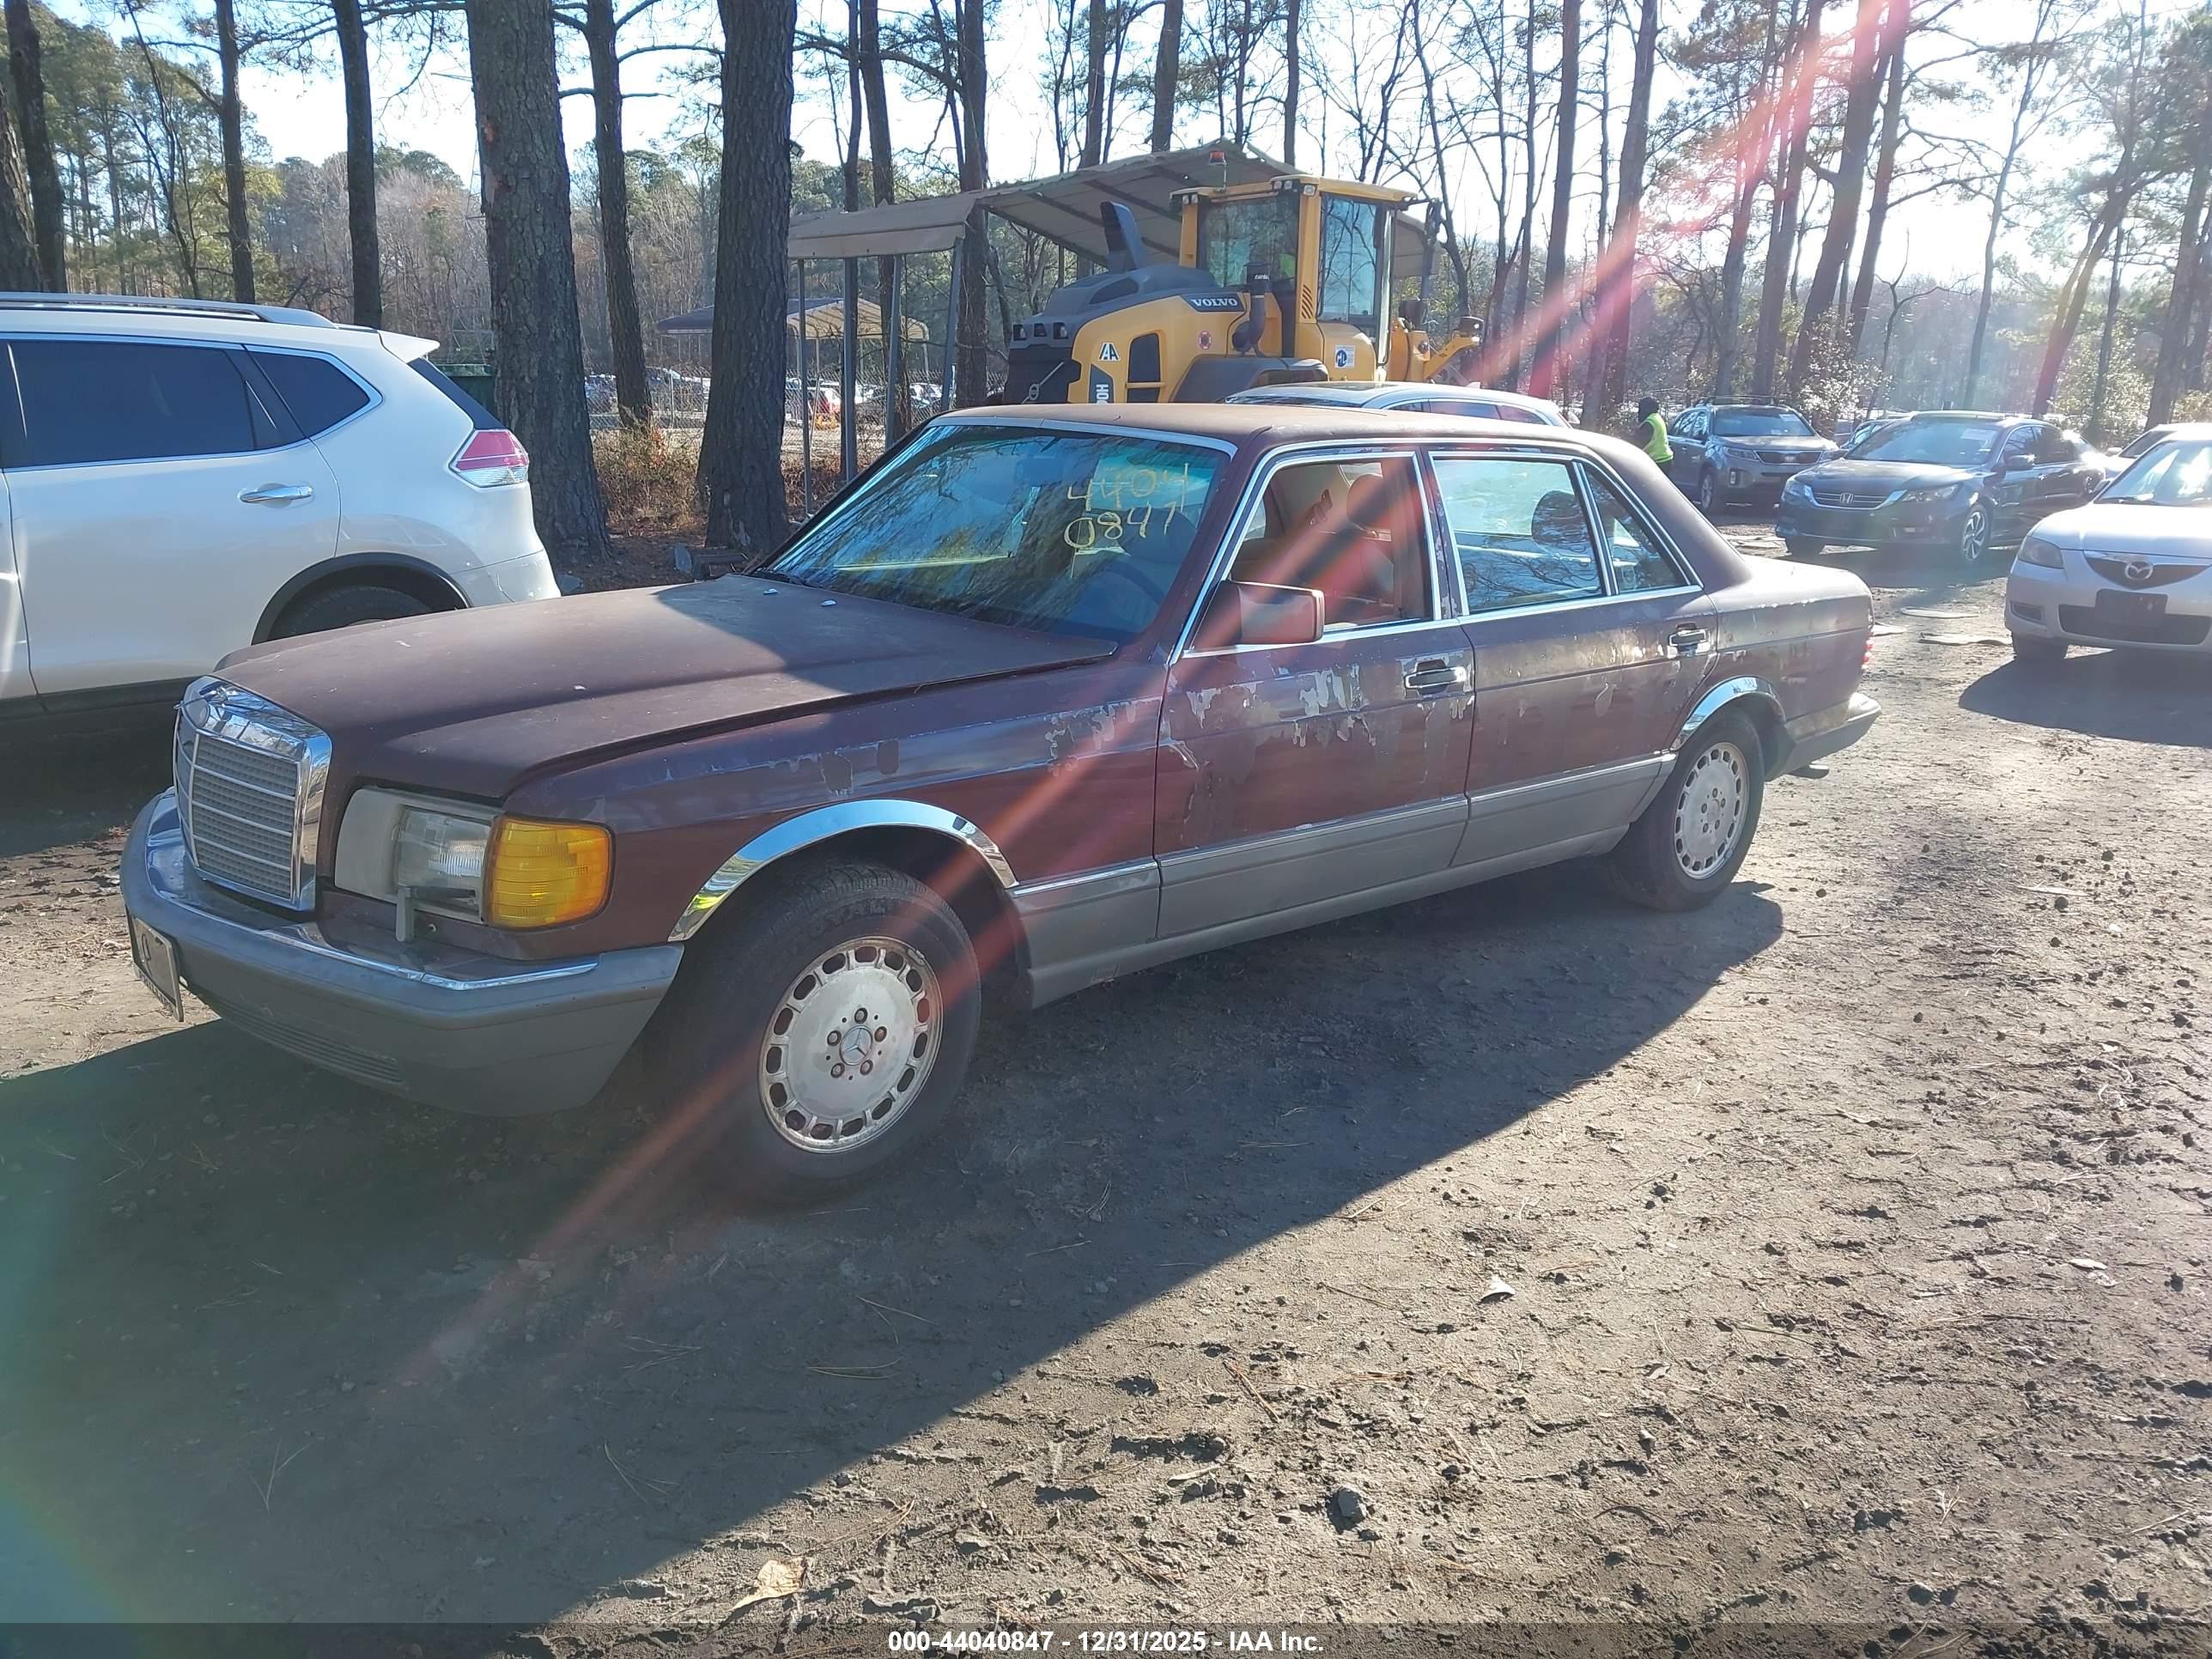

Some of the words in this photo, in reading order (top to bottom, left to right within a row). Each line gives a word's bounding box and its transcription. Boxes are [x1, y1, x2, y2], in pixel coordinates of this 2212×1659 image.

[1190, 297, 1238, 307] VOLVO
[1066, 462, 1189, 514] 4404
[1063, 501, 1177, 549] 0847
